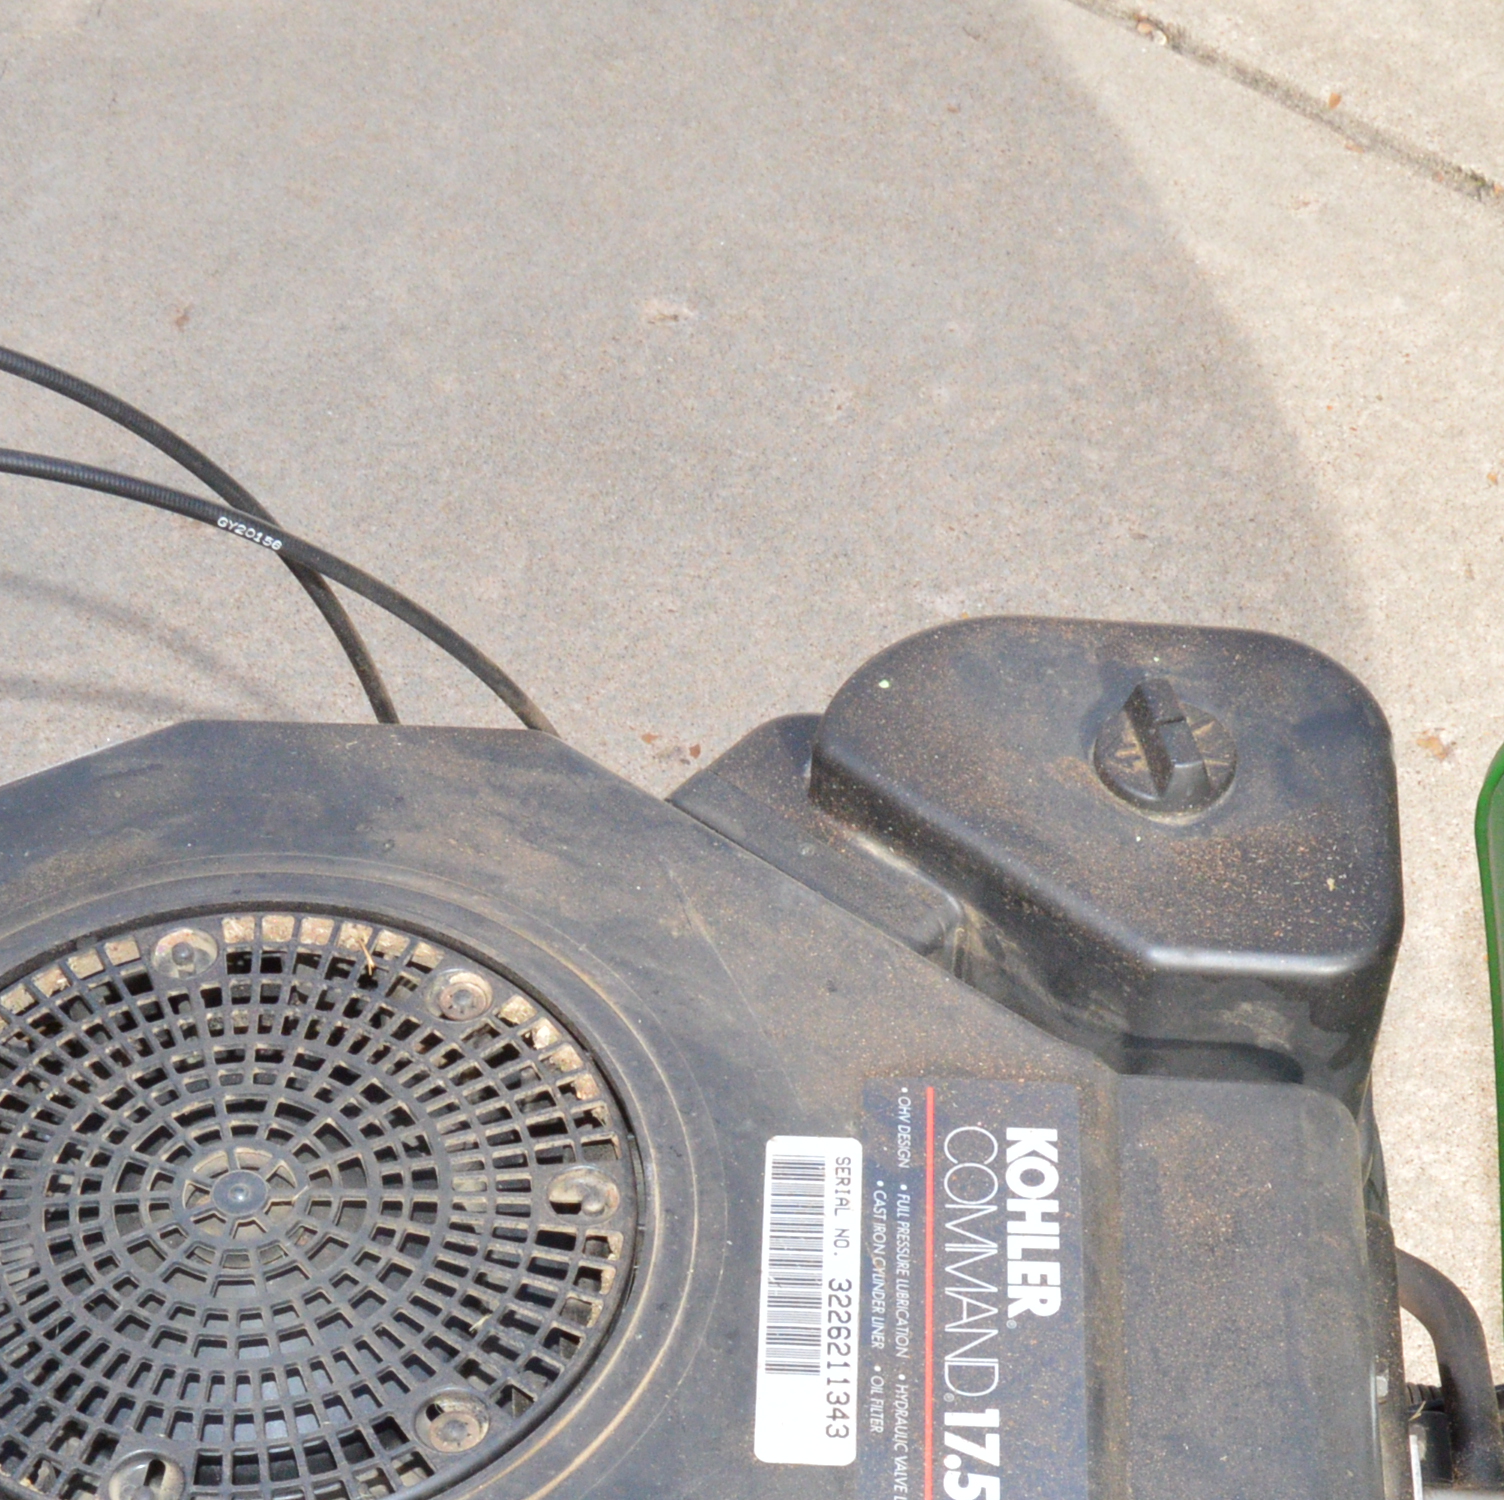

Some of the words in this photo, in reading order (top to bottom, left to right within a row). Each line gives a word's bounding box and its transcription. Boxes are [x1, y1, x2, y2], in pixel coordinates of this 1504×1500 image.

[898, 1096, 911, 1122] OHV
[897, 1124, 911, 1168] DESIGN
[834, 1156, 851, 1216] SERIAL
[873, 1189, 887, 1220] CAST
[896, 1193, 910, 1219] FULL
[833, 1228, 850, 1257] NO.
[872, 1222, 887, 1255] IRON
[1006, 1127, 1062, 1319] KOHLER
[896, 1220, 910, 1276] PRESSURE
[944, 1126, 1000, 1397] COMMAND
[871, 1256, 886, 1314] CYLINDER
[871, 1316, 884, 1350] LINER
[896, 1277, 910, 1358] LUBRICATION
[825, 1277, 852, 1439] 3226211343
[870, 1375, 884, 1395] OIL
[870, 1397, 884, 1433] FILTER
[893, 1383, 908, 1452] HYDRAULIC
[893, 1455, 908, 1493] VALVE
